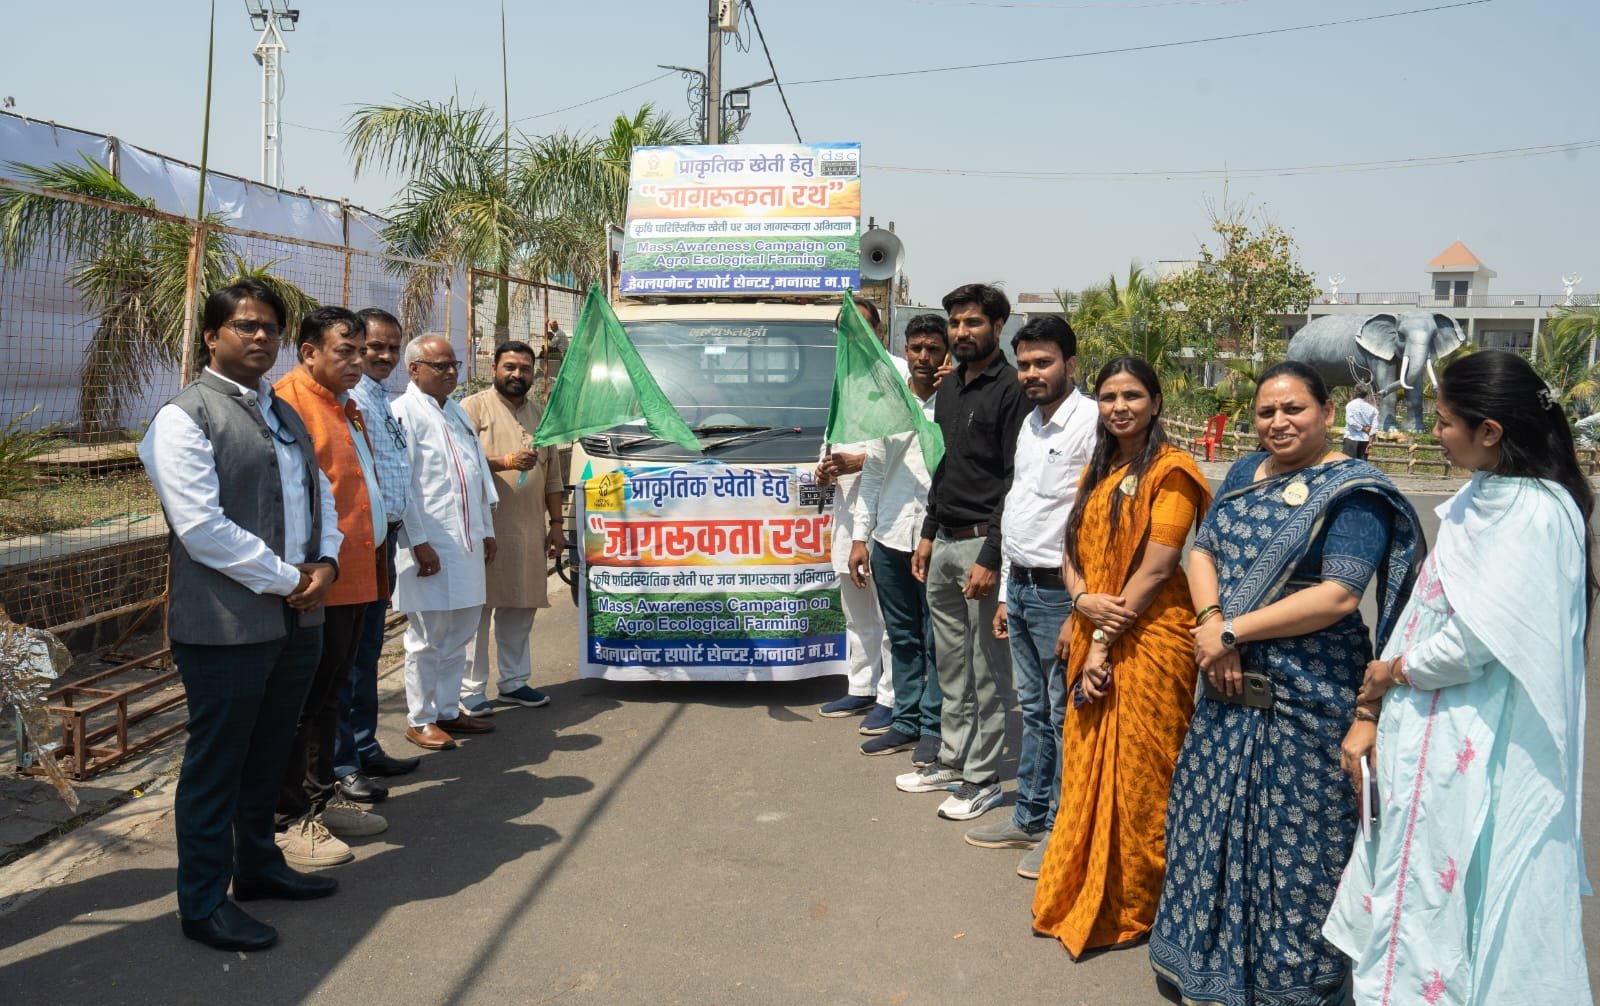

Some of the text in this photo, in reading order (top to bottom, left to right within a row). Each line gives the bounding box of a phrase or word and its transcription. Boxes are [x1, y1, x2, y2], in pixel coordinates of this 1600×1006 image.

[679, 152, 815, 179] प्राकृतिक खेती हेतु
[634, 222, 653, 236] कृषि
[708, 220, 728, 232] खेती
[730, 223, 741, 231] पर
[745, 222, 761, 231] जन
[813, 220, 852, 232] अभियान
[637, 241, 845, 252] Mass Awareness Campaign on
[655, 252, 825, 267] Agro Ecological Farming
[696, 274, 731, 289] सपोर्ट
[630, 469, 789, 507] प्राकृतिक खेती हेतु
[593, 571, 610, 589] कृषि
[673, 571, 697, 587] खेती
[699, 574, 713, 586] पर
[716, 574, 736, 586] जन
[738, 573, 790, 585] जागरूकता
[793, 569, 836, 585] अभियान
[599, 597, 829, 614] Mass Awareness Campaign on
[616, 616, 808, 634] Agro Ecological Farming
[664, 644, 704, 662] सपोर्ट
